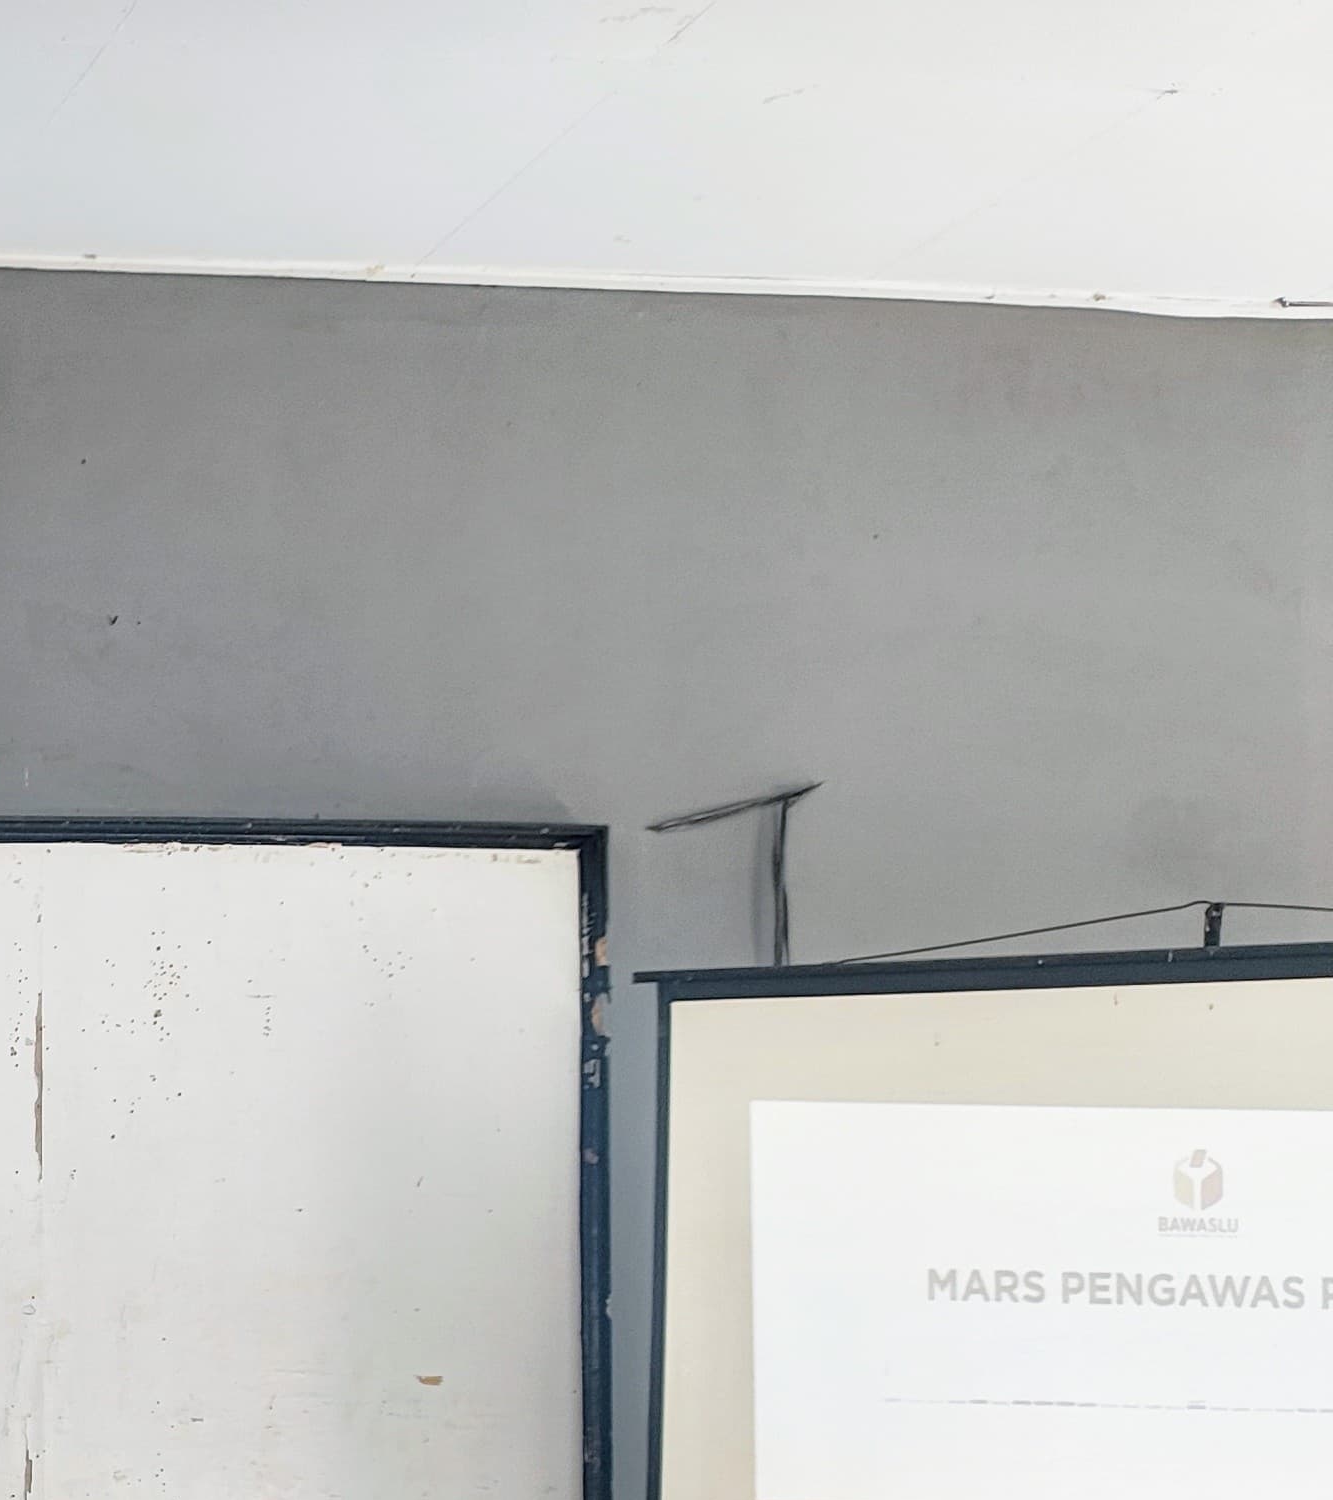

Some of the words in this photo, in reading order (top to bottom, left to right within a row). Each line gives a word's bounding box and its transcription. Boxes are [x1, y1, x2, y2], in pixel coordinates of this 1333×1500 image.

[1157, 1216, 1239, 1234] BAWASLU
[927, 1268, 1046, 1303] MARS
[1061, 1271, 1306, 1310] PENGAWAS
